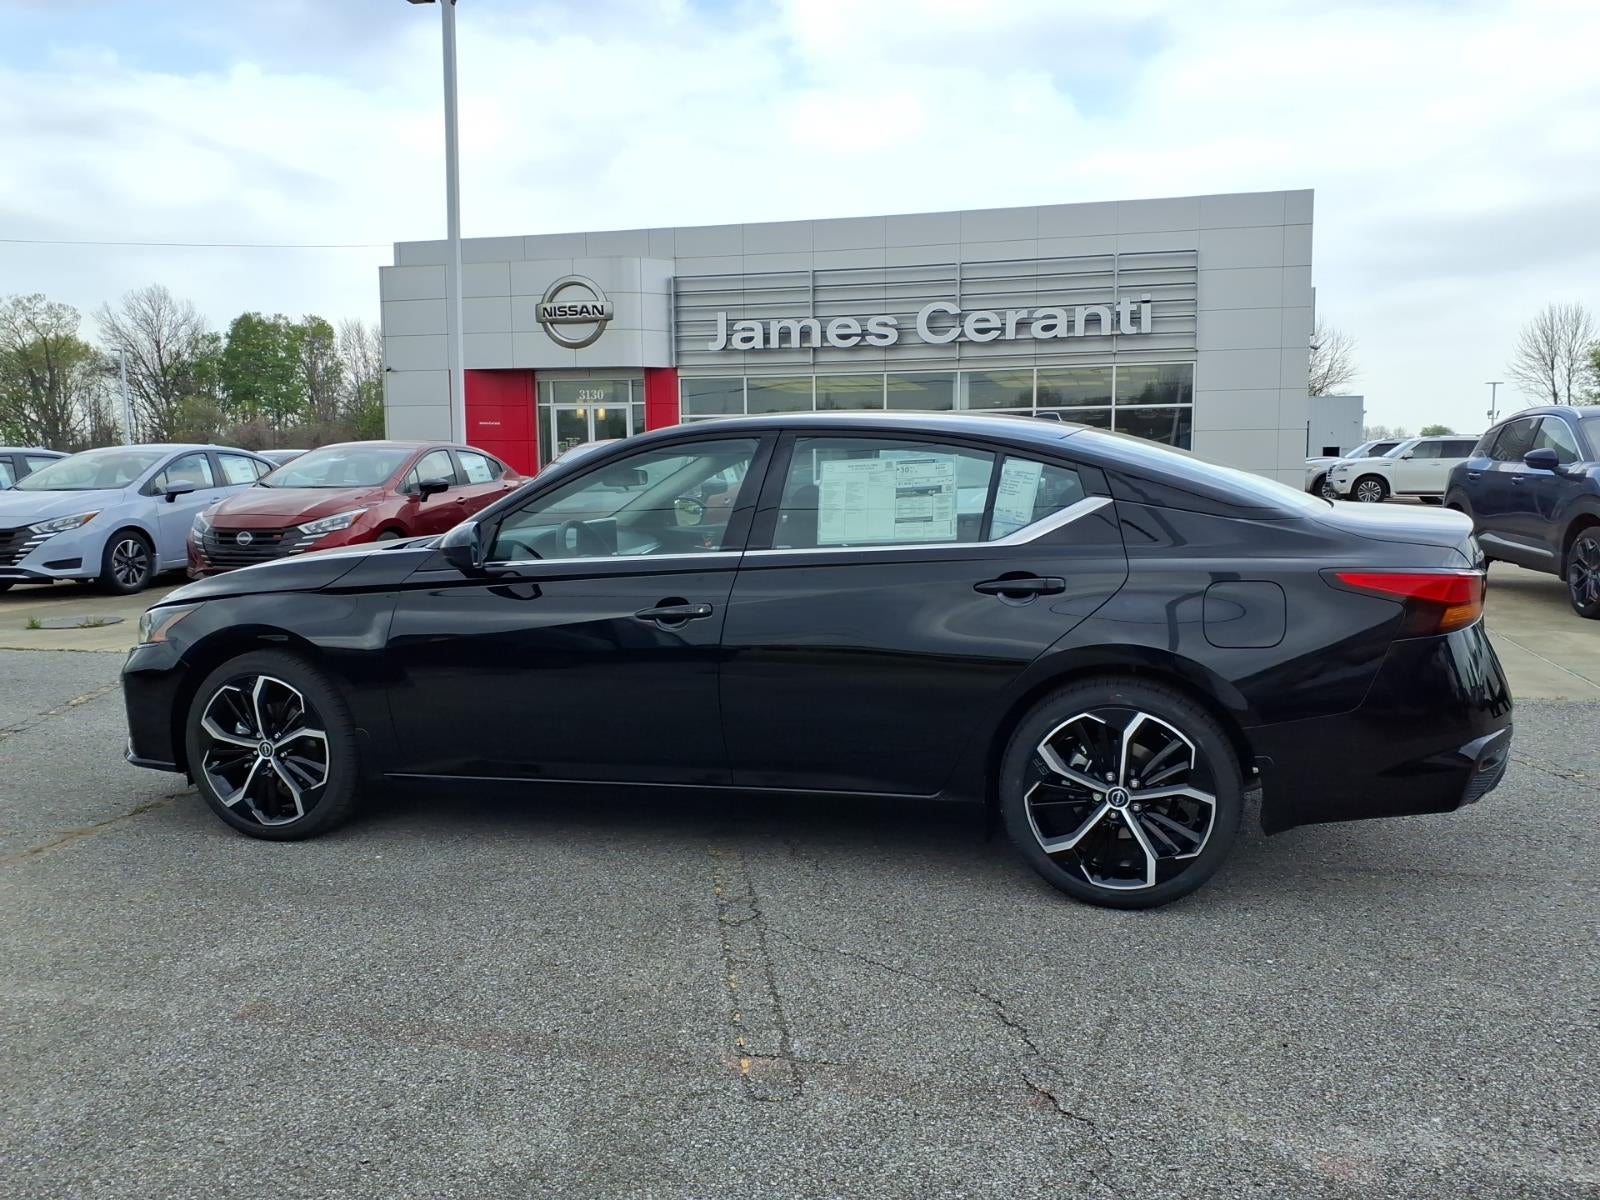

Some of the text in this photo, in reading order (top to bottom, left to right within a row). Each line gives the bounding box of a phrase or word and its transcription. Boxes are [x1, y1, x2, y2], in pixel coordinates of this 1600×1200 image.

[543, 304, 604, 318] NISSAN
[708, 294, 1152, 351] James Ceranti
[579, 389, 604, 400] 3130
